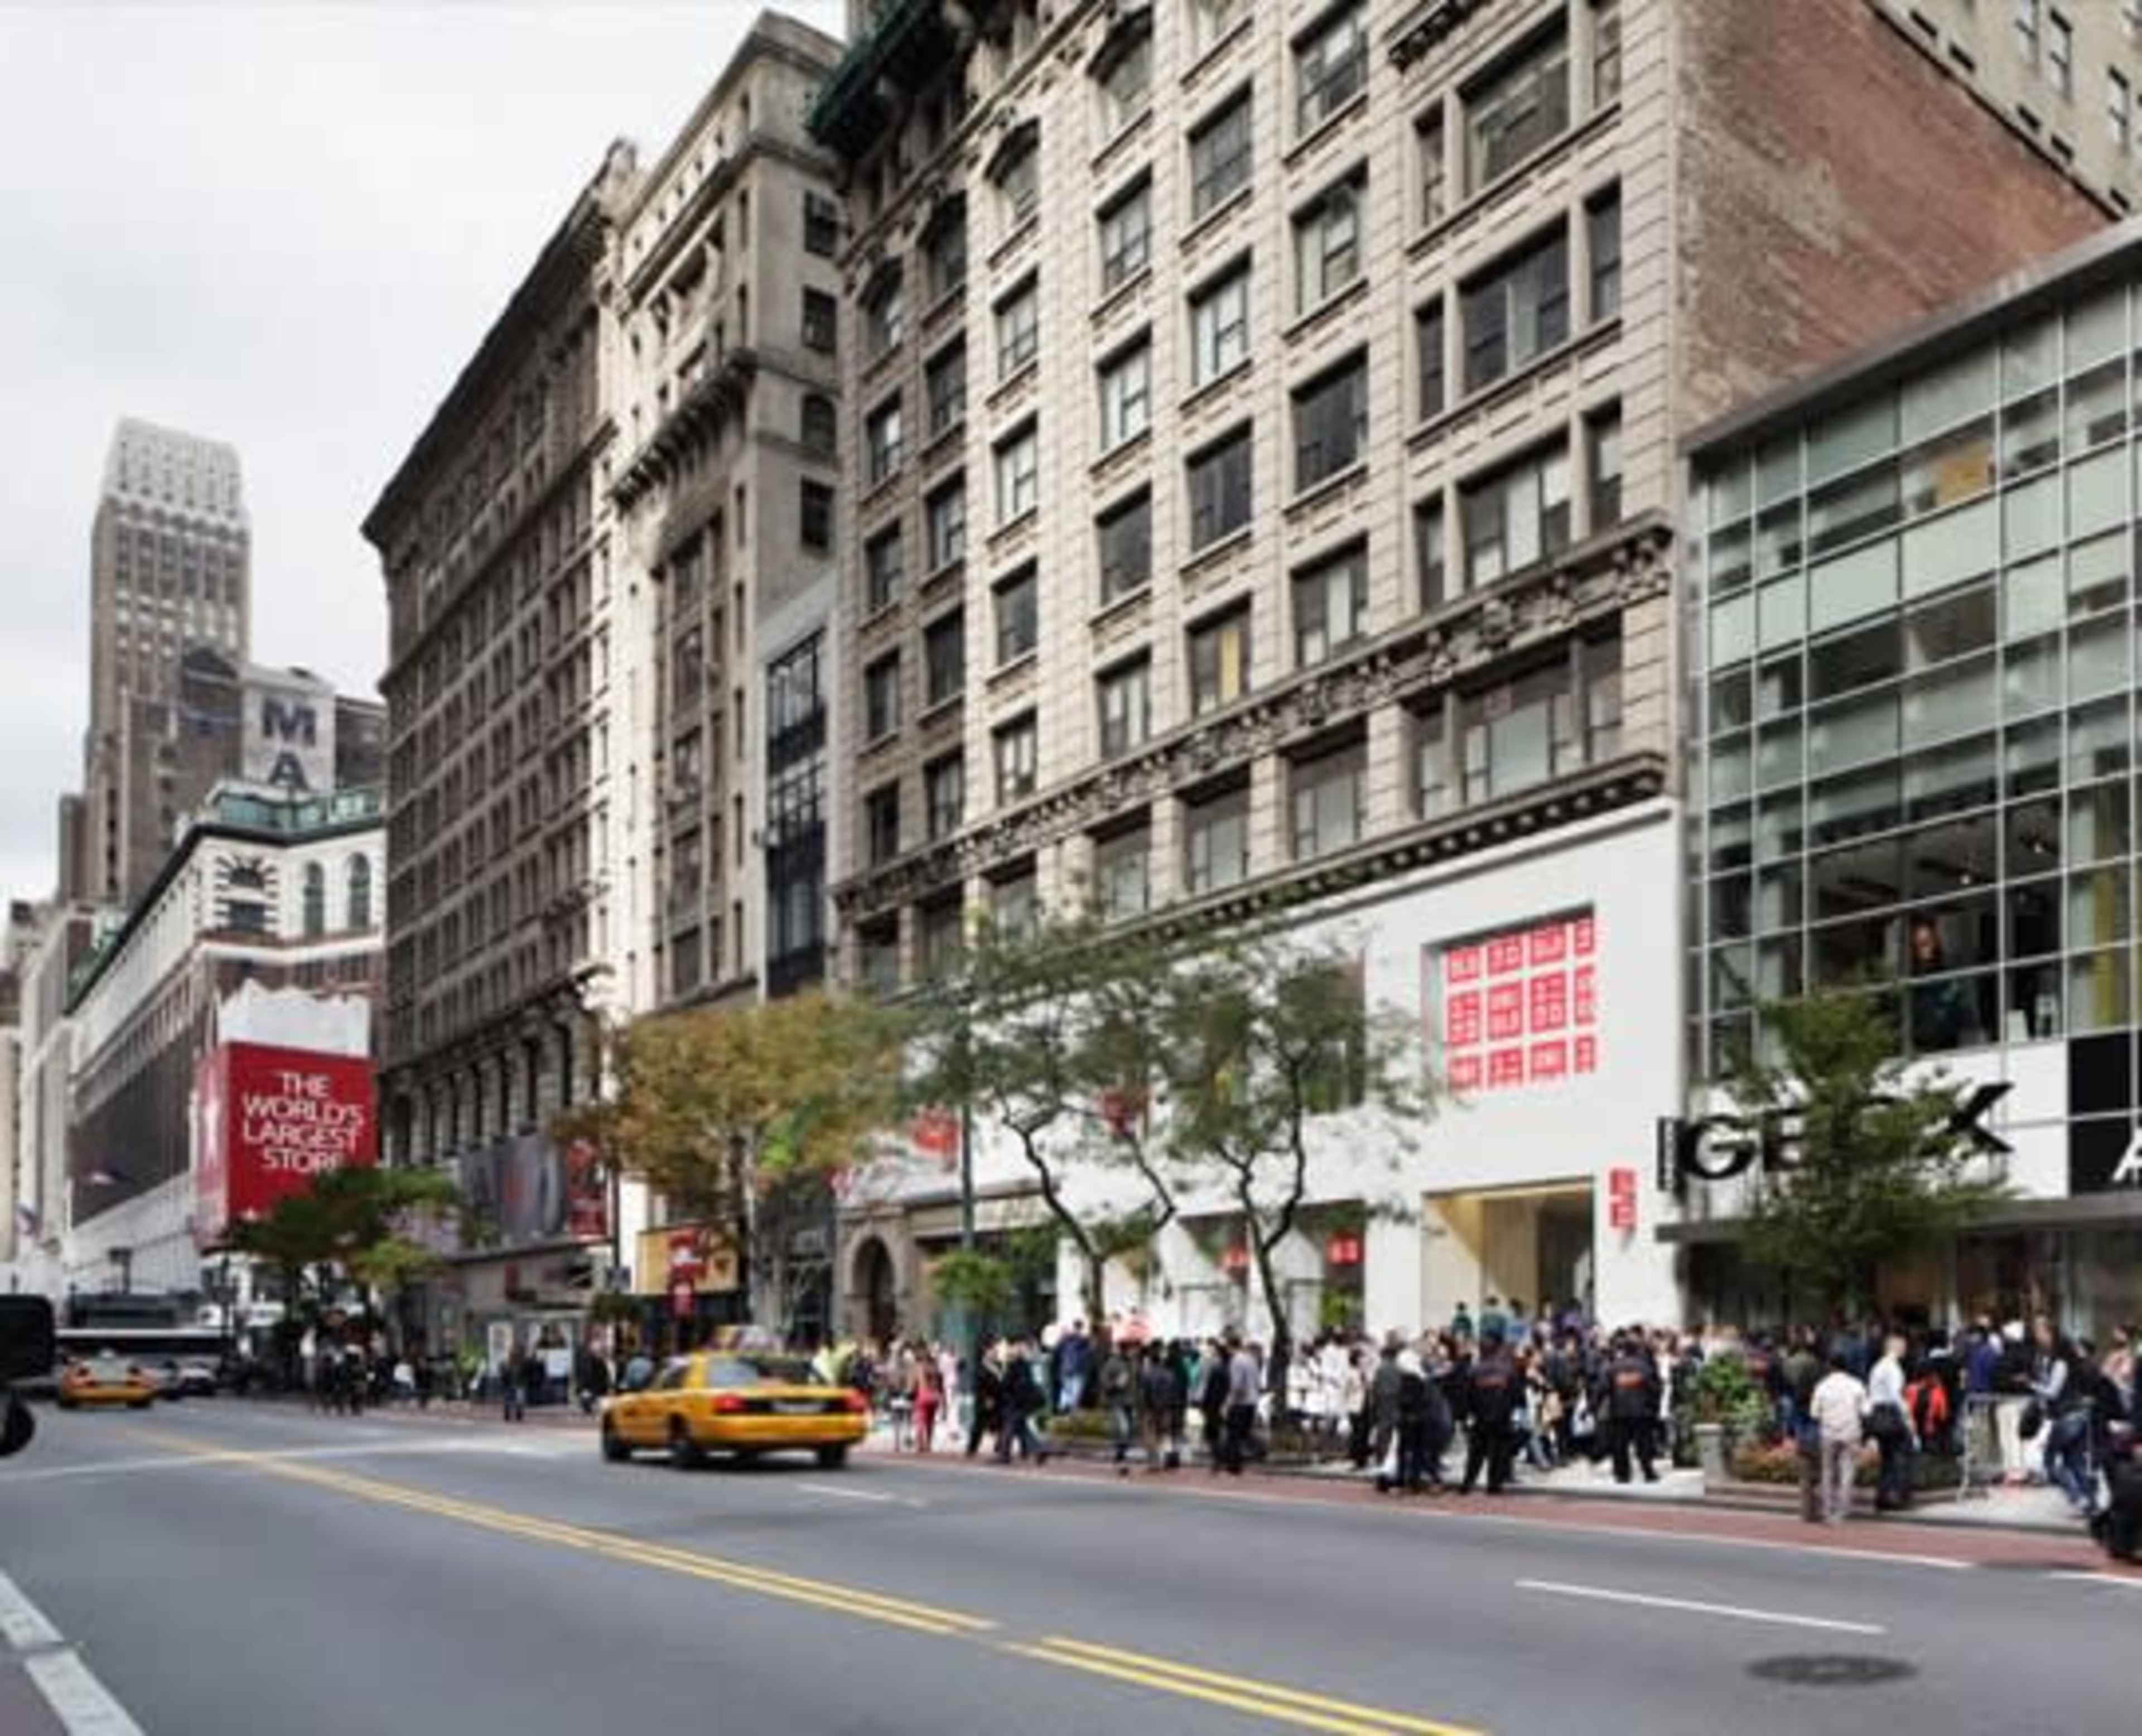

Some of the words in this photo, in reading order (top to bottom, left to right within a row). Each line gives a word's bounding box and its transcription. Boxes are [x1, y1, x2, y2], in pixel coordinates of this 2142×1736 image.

[277, 1072, 331, 1098] THE
[242, 1092, 365, 1127] WORLD'S
[243, 1118, 358, 1152] LARGEST
[1680, 1081, 2015, 1180] GEX
